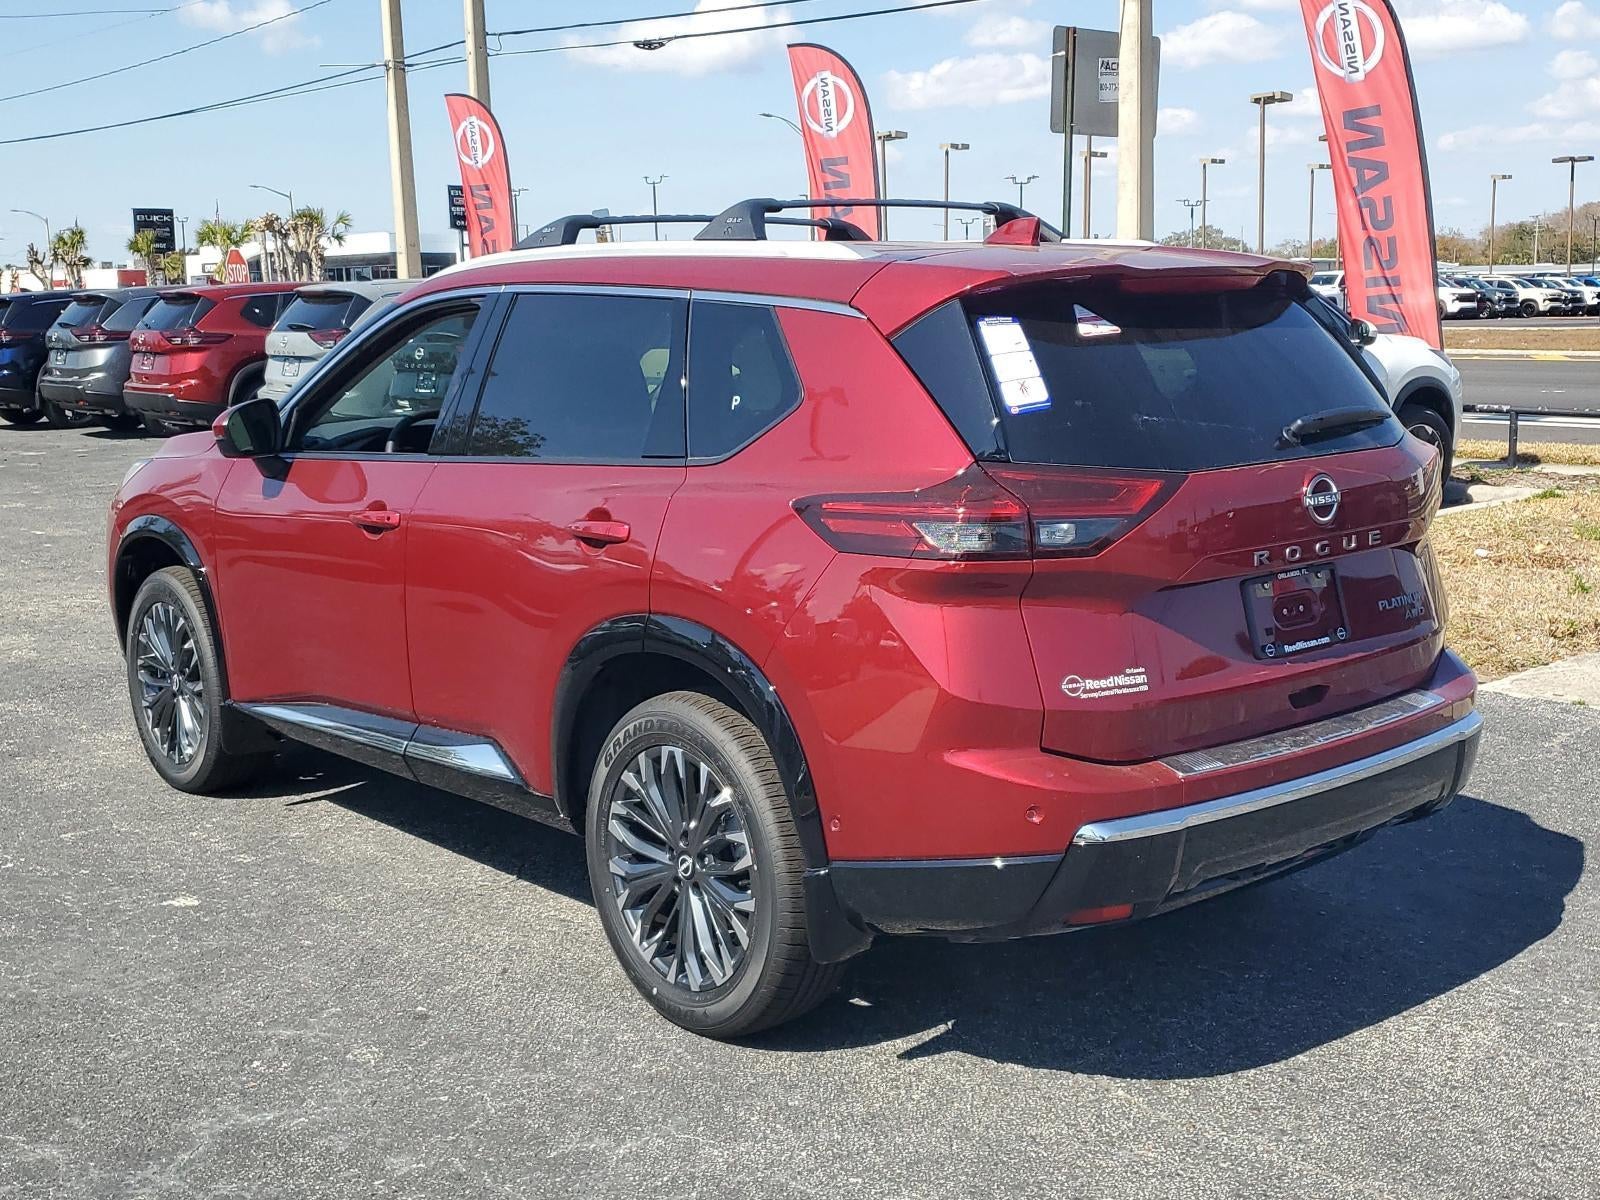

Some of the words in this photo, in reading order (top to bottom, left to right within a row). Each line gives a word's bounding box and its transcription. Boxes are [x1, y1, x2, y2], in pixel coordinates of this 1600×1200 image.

[136, 214, 172, 222] BUICK
[228, 263, 247, 283] STOP
[1253, 530, 1383, 567] ROGUE
